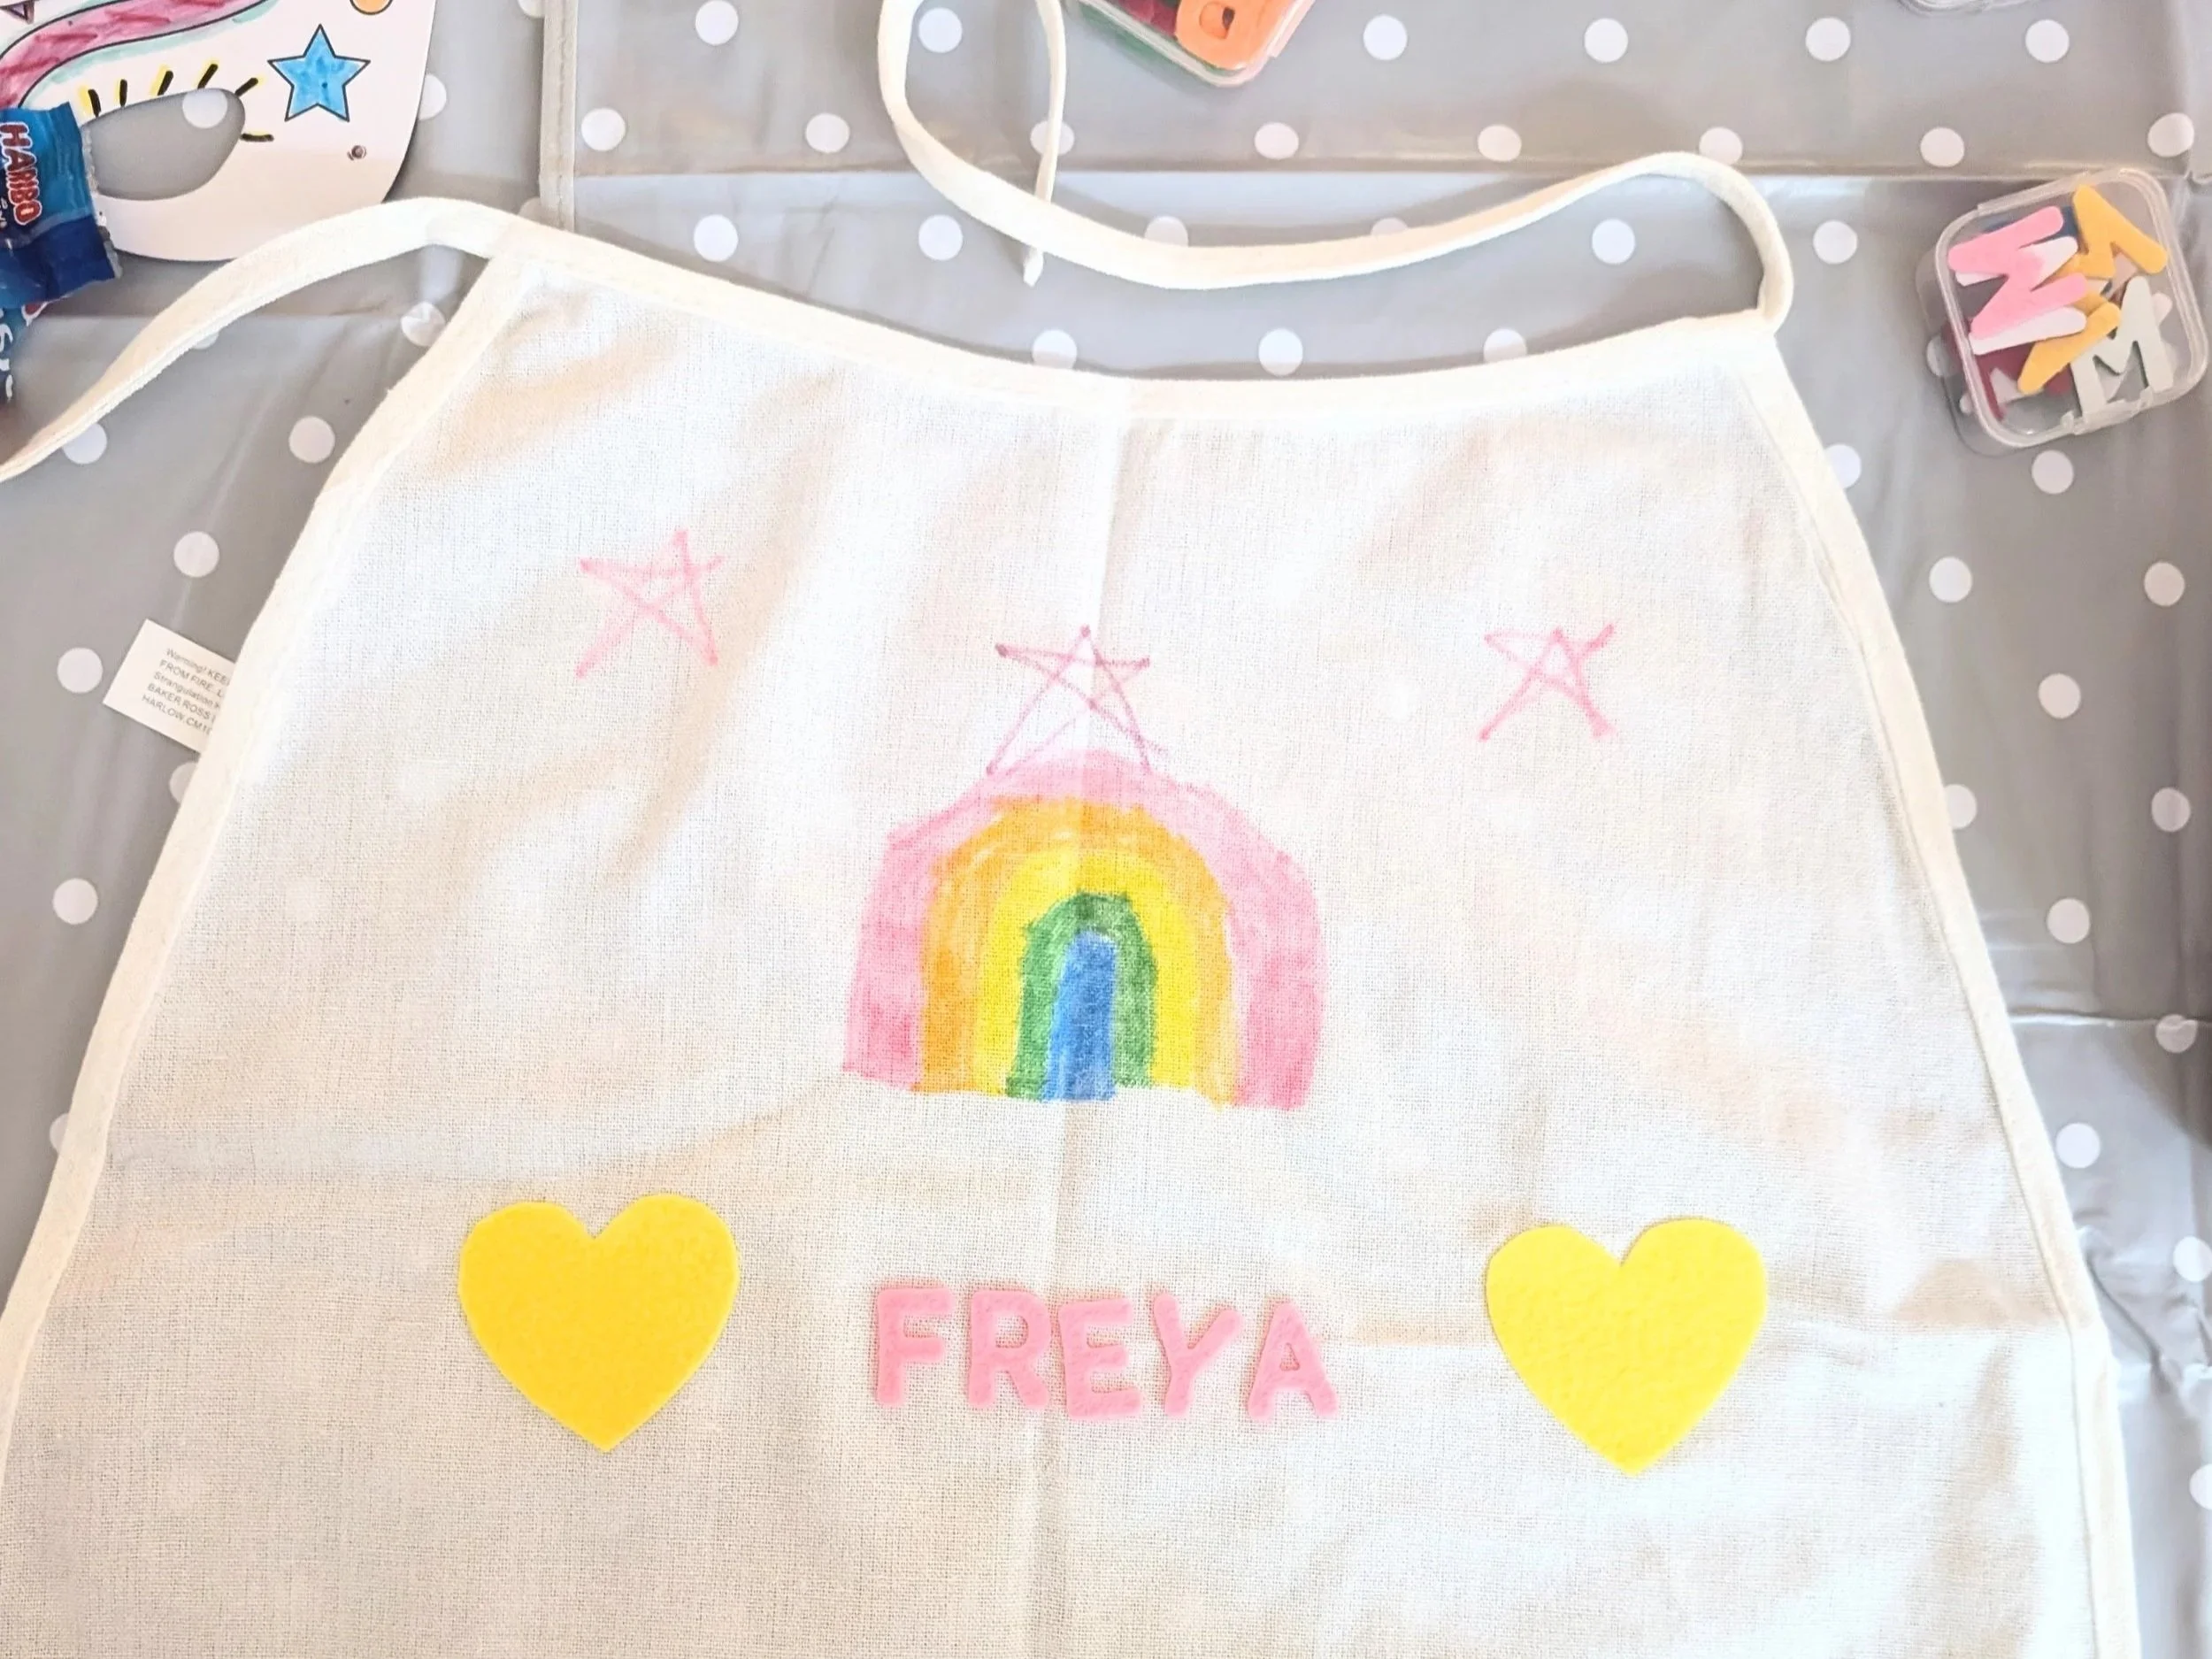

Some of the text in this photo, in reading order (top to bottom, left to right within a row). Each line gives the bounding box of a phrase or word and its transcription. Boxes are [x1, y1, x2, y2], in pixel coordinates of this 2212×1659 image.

[0, 122, 42, 226] HARIBO
[148, 683, 181, 705] BAKER
[182, 699, 211, 720] ROSS
[159, 659, 190, 679] FROM
[876, 1287, 1338, 1421] FREYA
